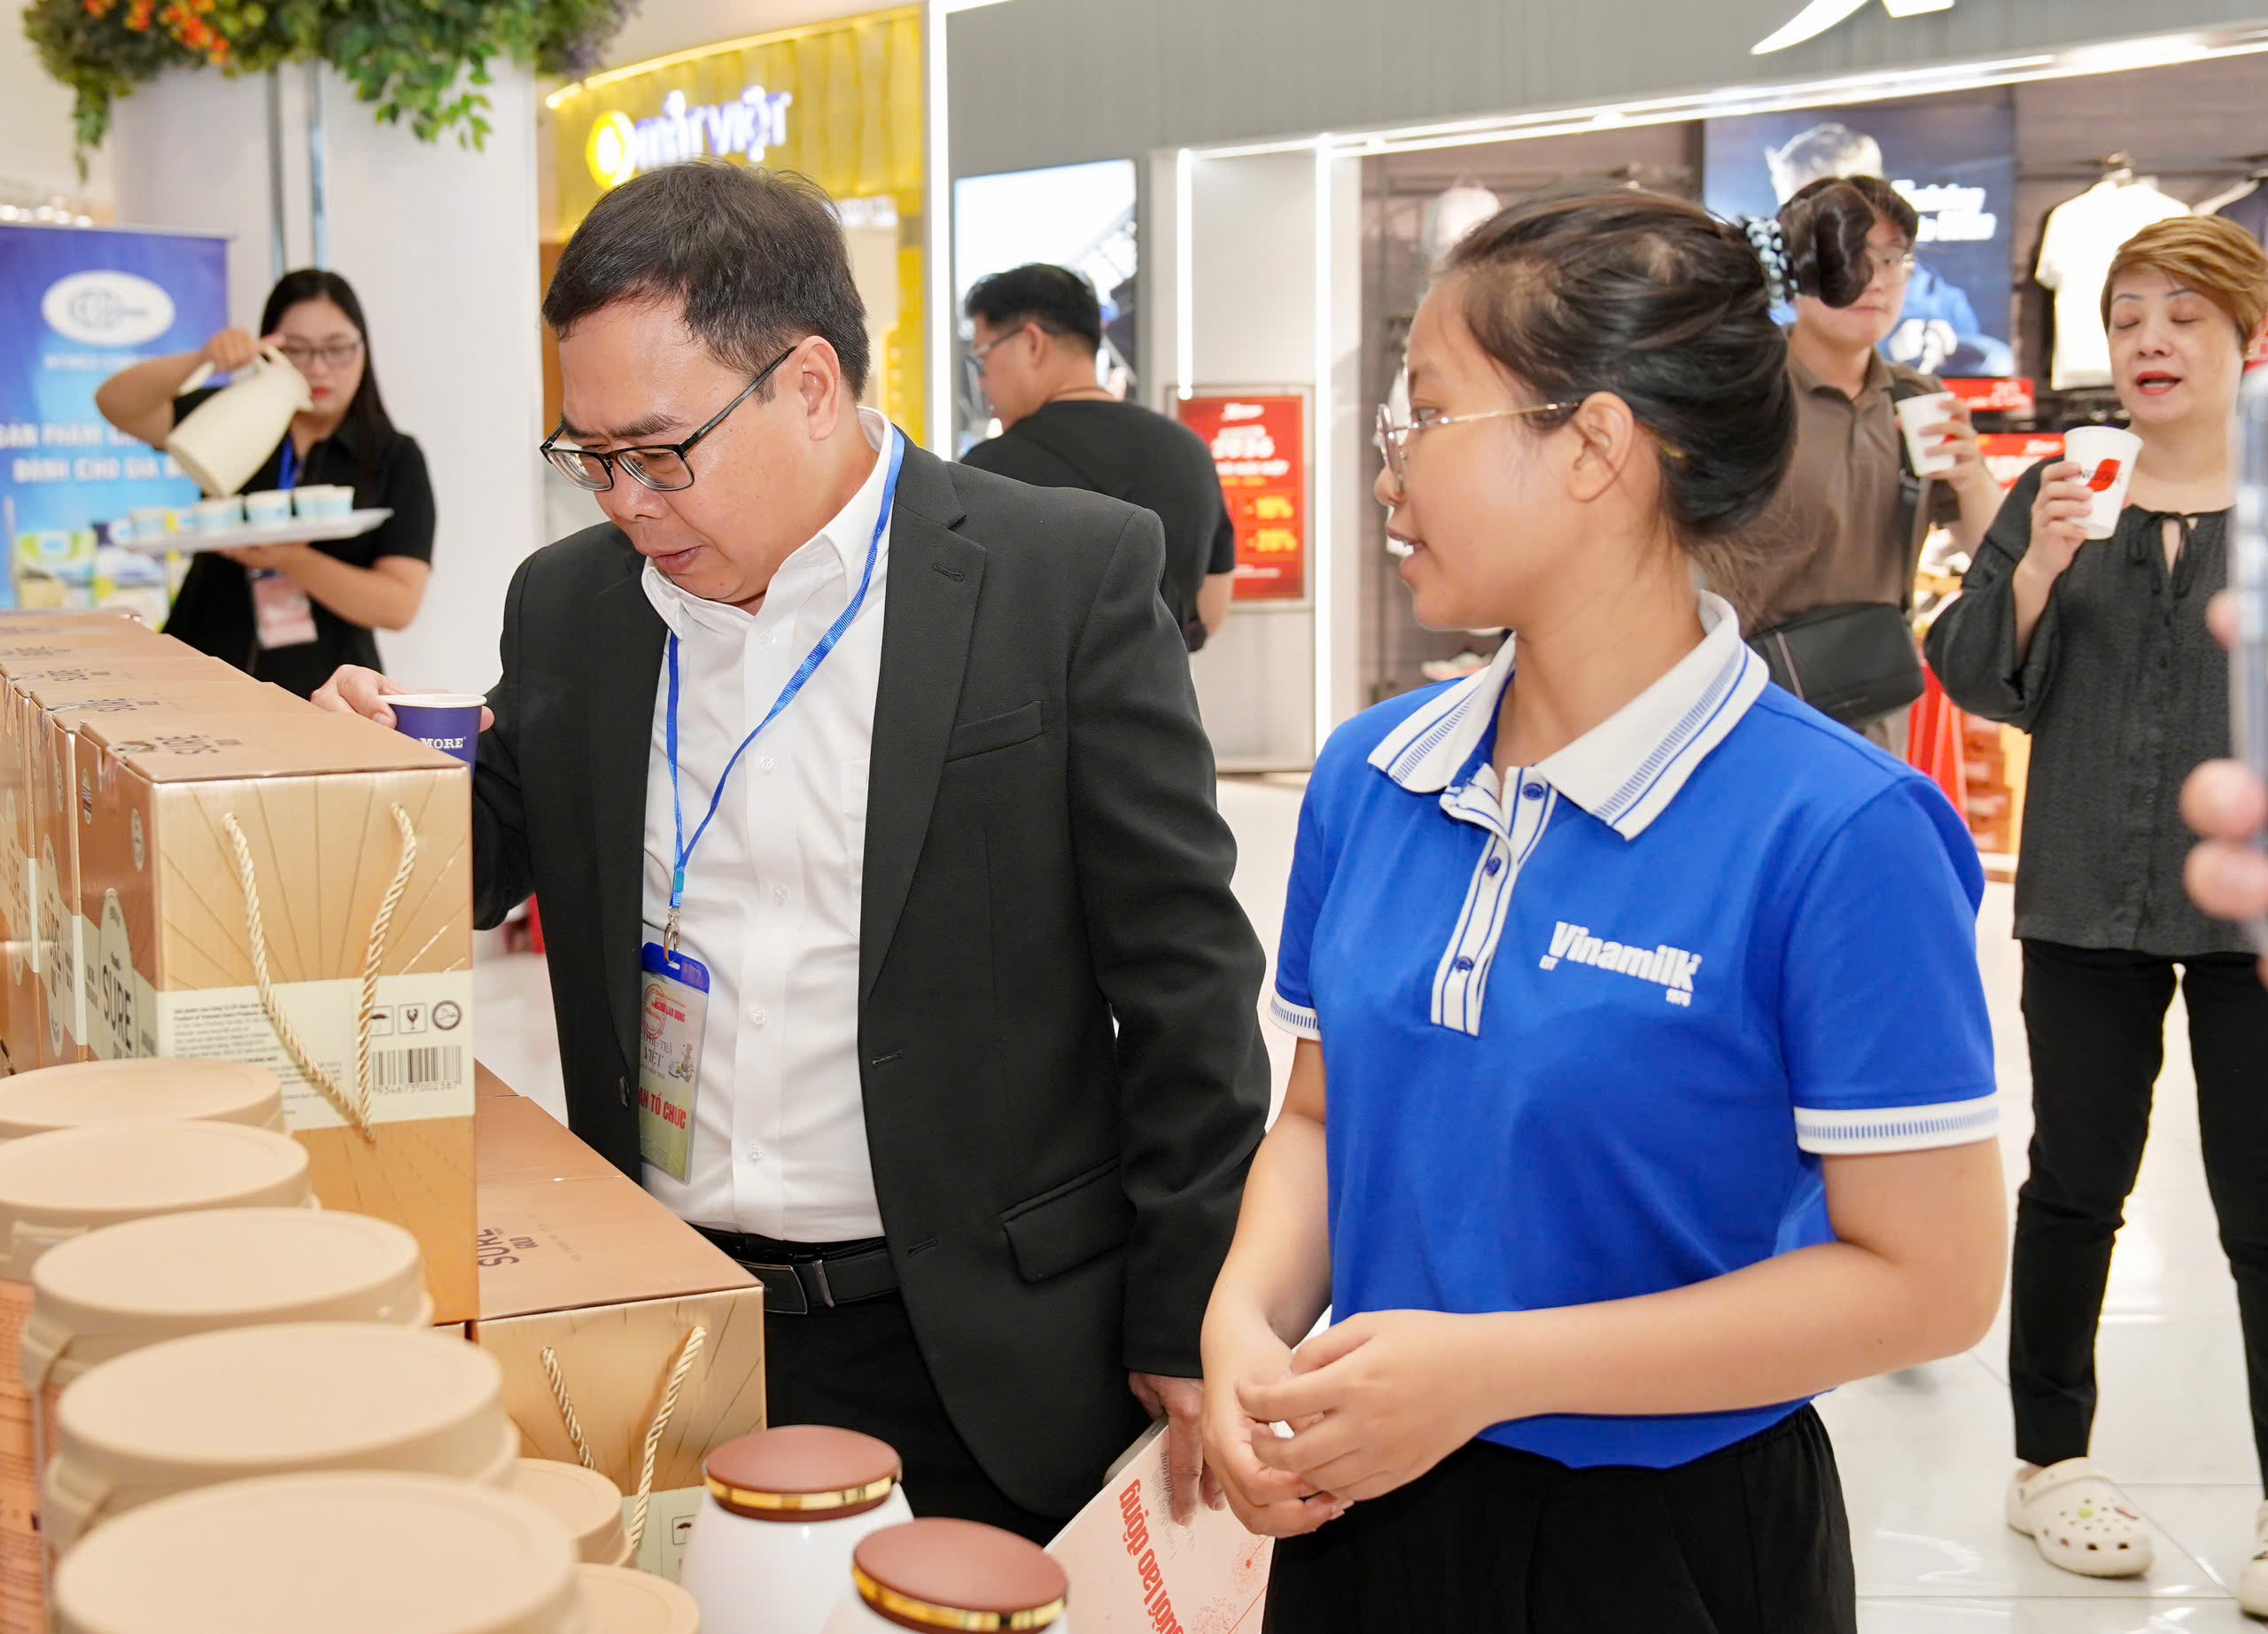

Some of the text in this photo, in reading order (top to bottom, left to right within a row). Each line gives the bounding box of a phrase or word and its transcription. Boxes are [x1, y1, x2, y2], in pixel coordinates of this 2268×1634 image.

[1549, 921, 1703, 992] Vinamilk
[103, 964, 133, 1052] SURE
[1119, 1478, 1149, 1556] động
[1138, 1548, 1163, 1606] lao
